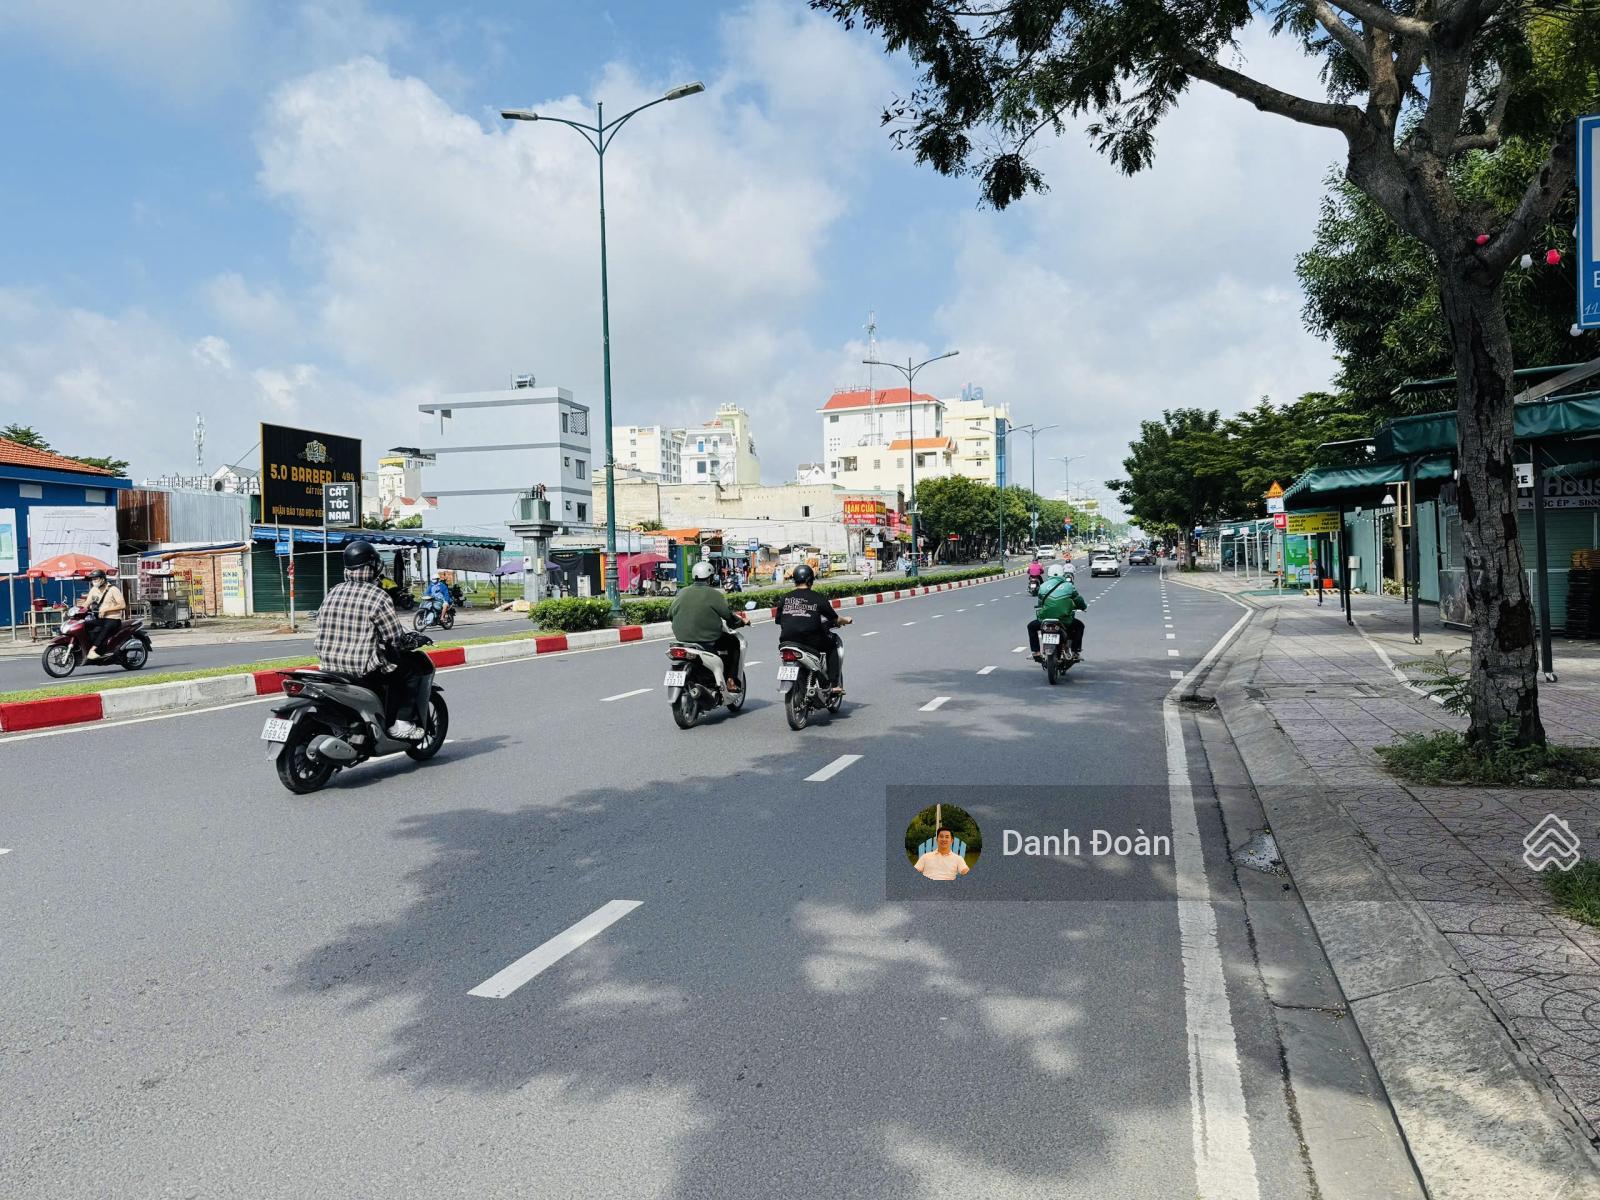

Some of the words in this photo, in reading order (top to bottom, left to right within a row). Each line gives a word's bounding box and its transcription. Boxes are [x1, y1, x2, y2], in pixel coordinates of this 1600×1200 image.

[270, 463, 288, 481] 5.0
[291, 466, 333, 484] BARBER
[328, 511, 351, 521] NAM
